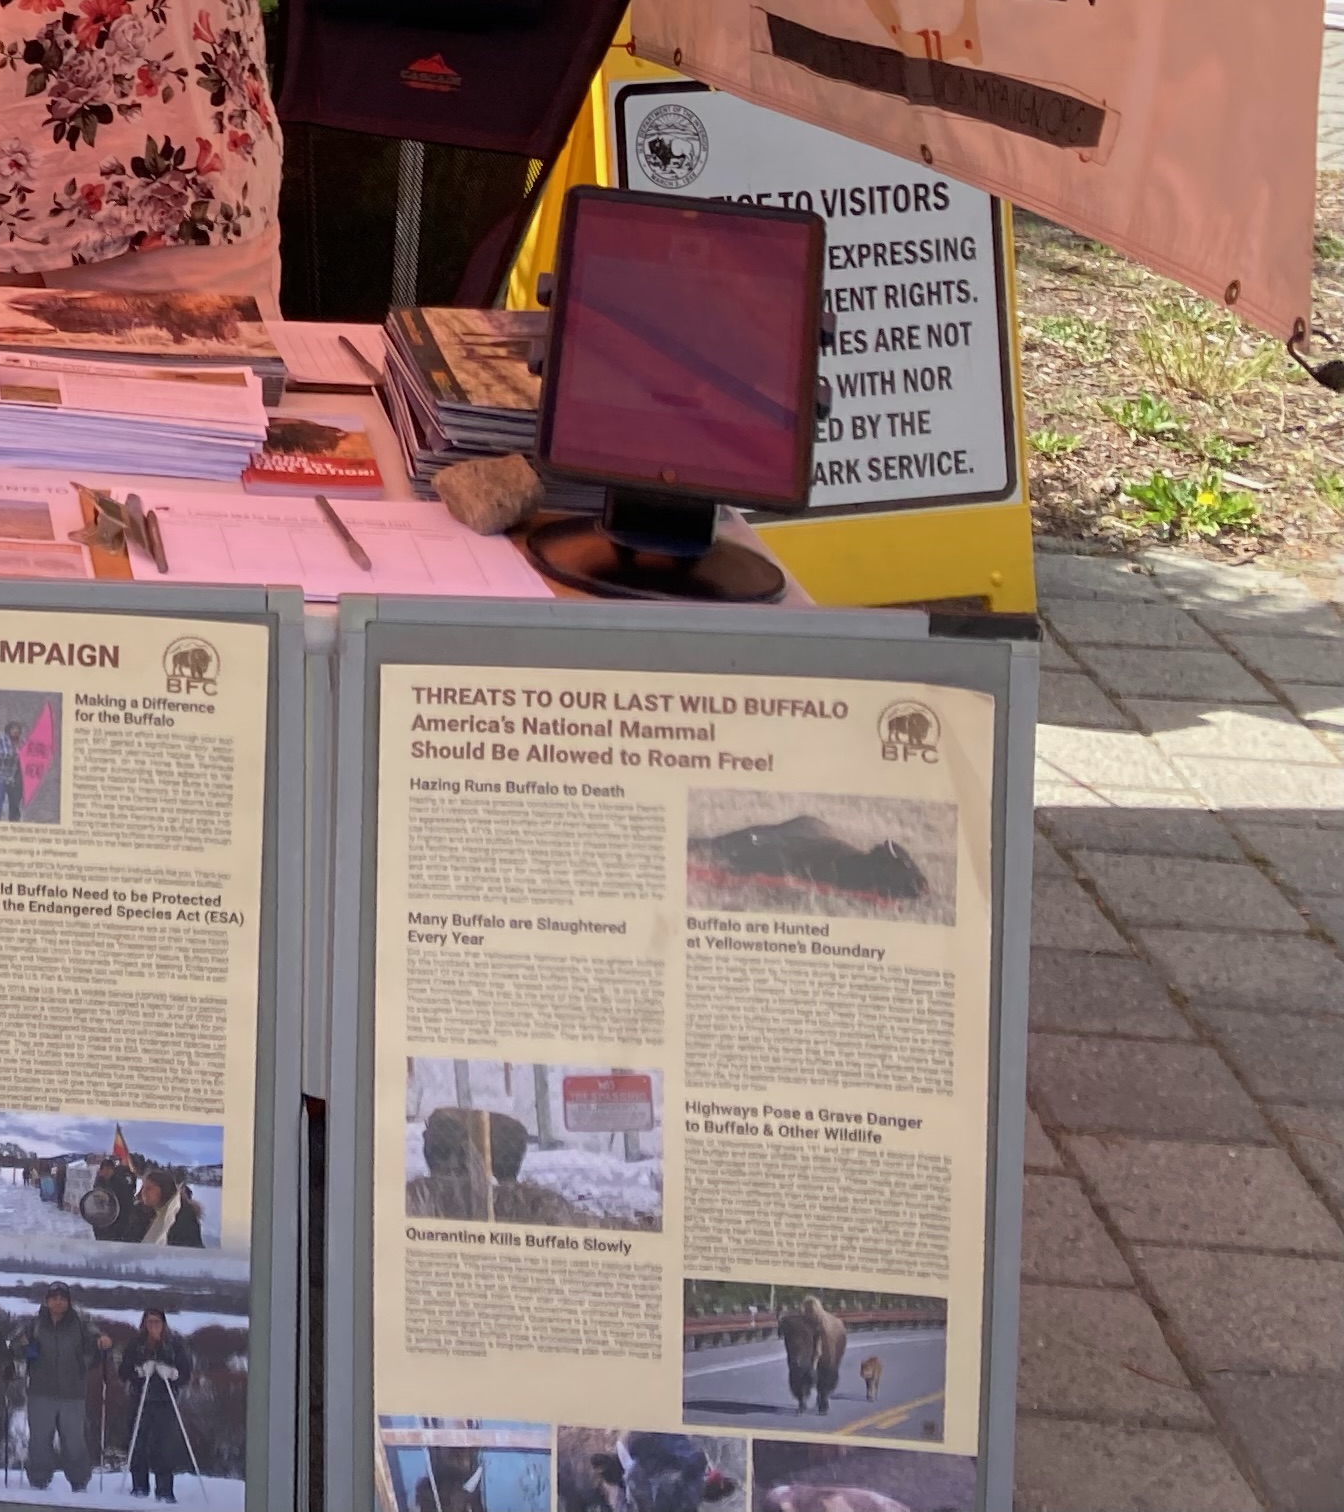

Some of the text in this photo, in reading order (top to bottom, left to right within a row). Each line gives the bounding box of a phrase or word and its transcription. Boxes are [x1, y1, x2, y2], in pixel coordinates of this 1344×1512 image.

[820, 181, 951, 218] VISITORS
[828, 236, 976, 269] EXPRESSING
[884, 279, 977, 308] RIGHTS.
[874, 324, 920, 352] ARE
[926, 321, 971, 347] NOT
[836, 369, 895, 398] WITH
[902, 365, 952, 393] NOR
[851, 414, 881, 440] BY
[885, 409, 931, 437] THE
[812, 449, 973, 486] ARK SERVICE.
[166, 677, 217, 696] BFC
[75, 694, 214, 713] Making a Difference
[411, 686, 848, 718] THREATS TO OUR LAST WILD BUFFALO
[74, 709, 174, 726] for the Buffalo
[411, 713, 714, 740] America's National Mammal
[411, 740, 772, 770] Should Be Allowed to Roam Free!
[881, 742, 938, 763] BFC
[409, 777, 624, 796] Hazing Runs Buffalo to Death
[17, 885, 67, 897] Buffalo
[72, 887, 108, 900] Need
[112, 890, 126, 901] to
[130, 890, 147, 902] be
[152, 891, 221, 906] Protected
[2, 899, 24, 911] the
[28, 900, 112, 917] Endangered
[116, 905, 171, 919] Species
[176, 909, 199, 921] Act
[204, 910, 244, 926] (ESA)
[407, 911, 625, 934] Many Buffalo are Slaughtered
[407, 929, 484, 946] Every Year
[686, 916, 829, 937] Buffalo are Hunted
[686, 935, 885, 961] at Yellowstone's Boundary
[685, 1101, 922, 1130] Highways Pose a Grave Danger
[685, 1119, 881, 1143] to Buffalo & Other Wildlife
[405, 1227, 631, 1256] Quarantine Kills Buffalo Slowly
